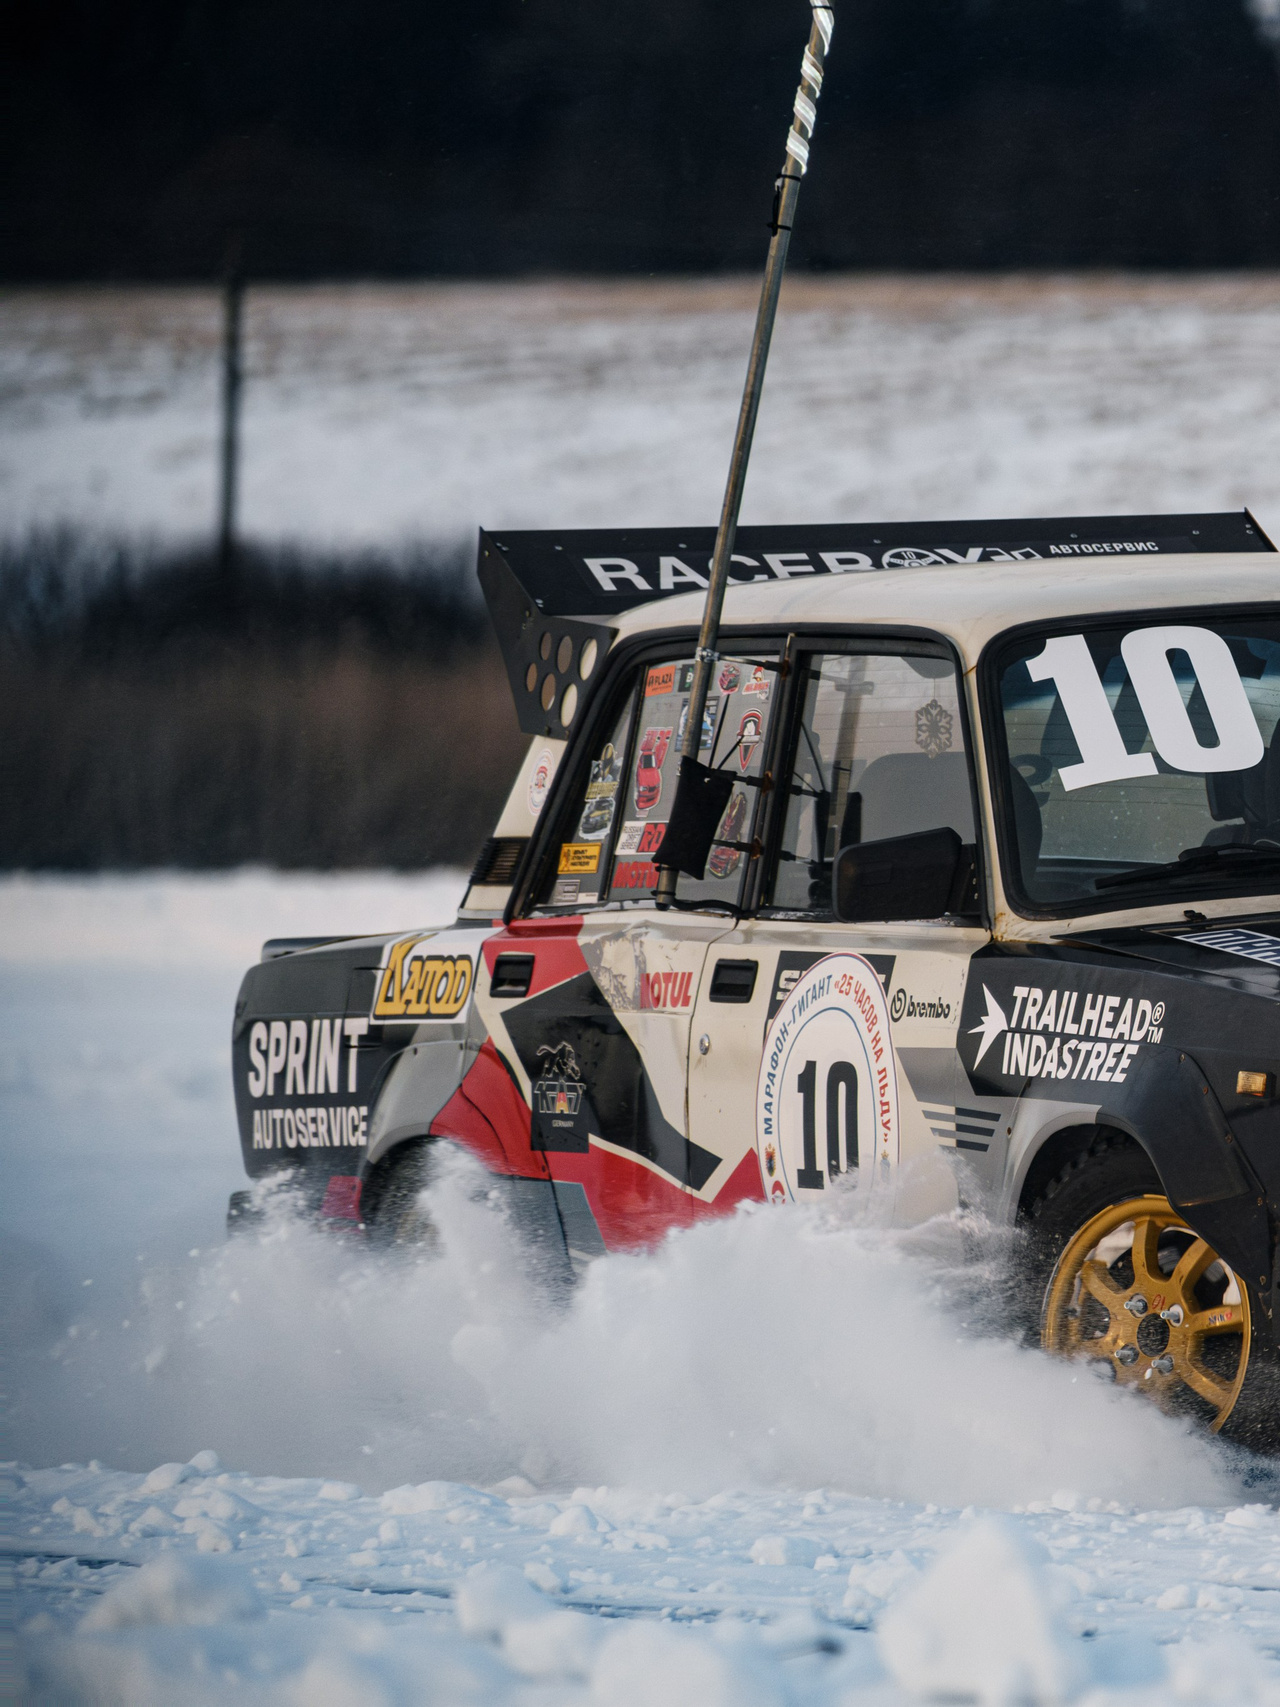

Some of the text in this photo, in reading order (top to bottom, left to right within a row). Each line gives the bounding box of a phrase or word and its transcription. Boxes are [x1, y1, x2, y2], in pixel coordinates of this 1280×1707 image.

[1049, 541, 1159, 555] АВТОСЕРВИС
[1025, 625, 1265, 792] 10
[637, 823, 667, 853] RD
[612, 861, 660, 889] MOTU
[640, 972, 693, 1009] MOTUL
[906, 997, 951, 1019] brembo
[248, 1017, 369, 1098] SPRINT
[764, 974, 833, 1135] МАРАФОН-ГИГАНТ
[854, 980, 878, 1033] ЧАСОВ
[871, 1031, 884, 1063] НА
[1002, 1032, 1140, 1083] INDASTREE
[253, 1106, 368, 1149] AUTOSERVICE
[797, 1060, 859, 1192] 10
